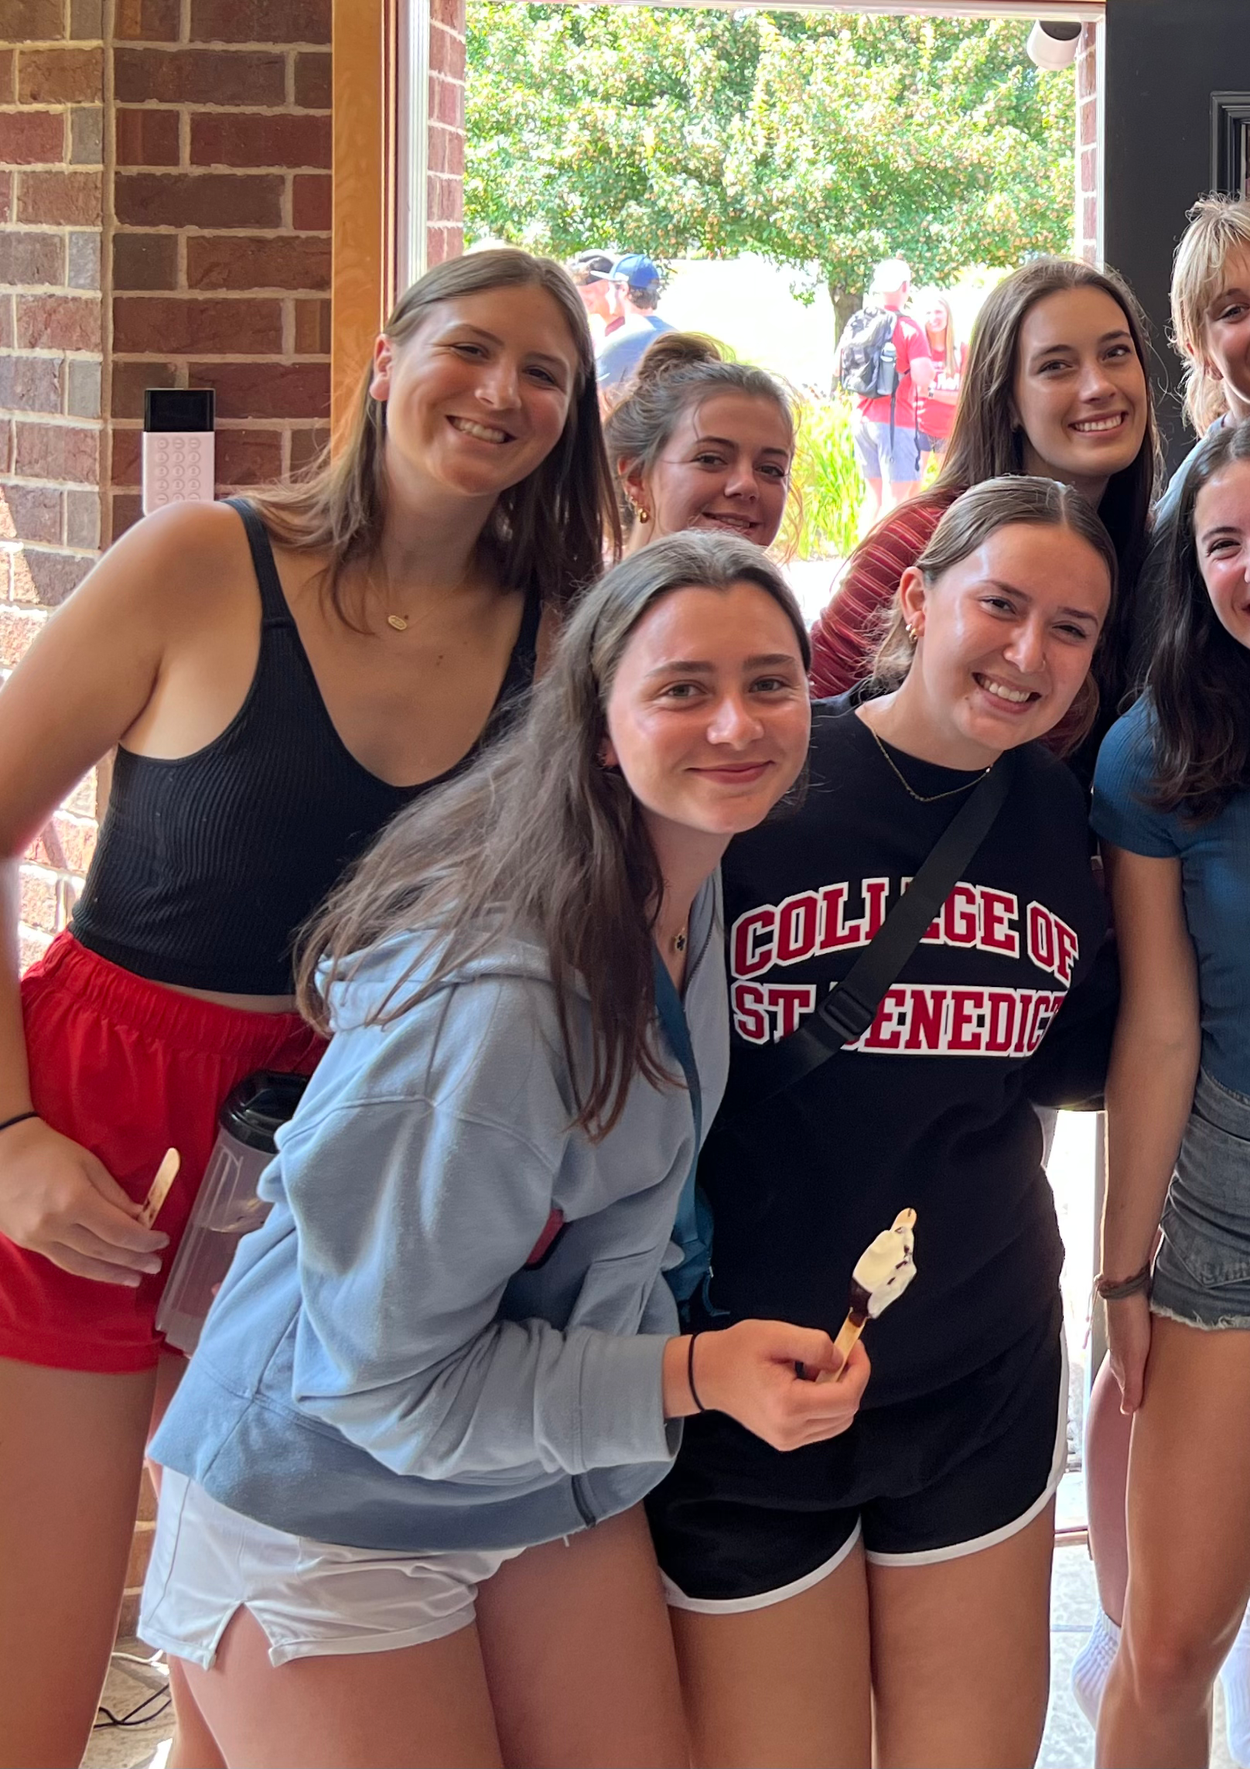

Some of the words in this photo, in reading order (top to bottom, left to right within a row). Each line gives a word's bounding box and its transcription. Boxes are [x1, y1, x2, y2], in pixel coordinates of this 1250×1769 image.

[731, 877, 1020, 980] COLLGE
[1027, 900, 1079, 989] OF
[731, 979, 817, 1044] ST
[829, 980, 1069, 1058] ENEDIC
